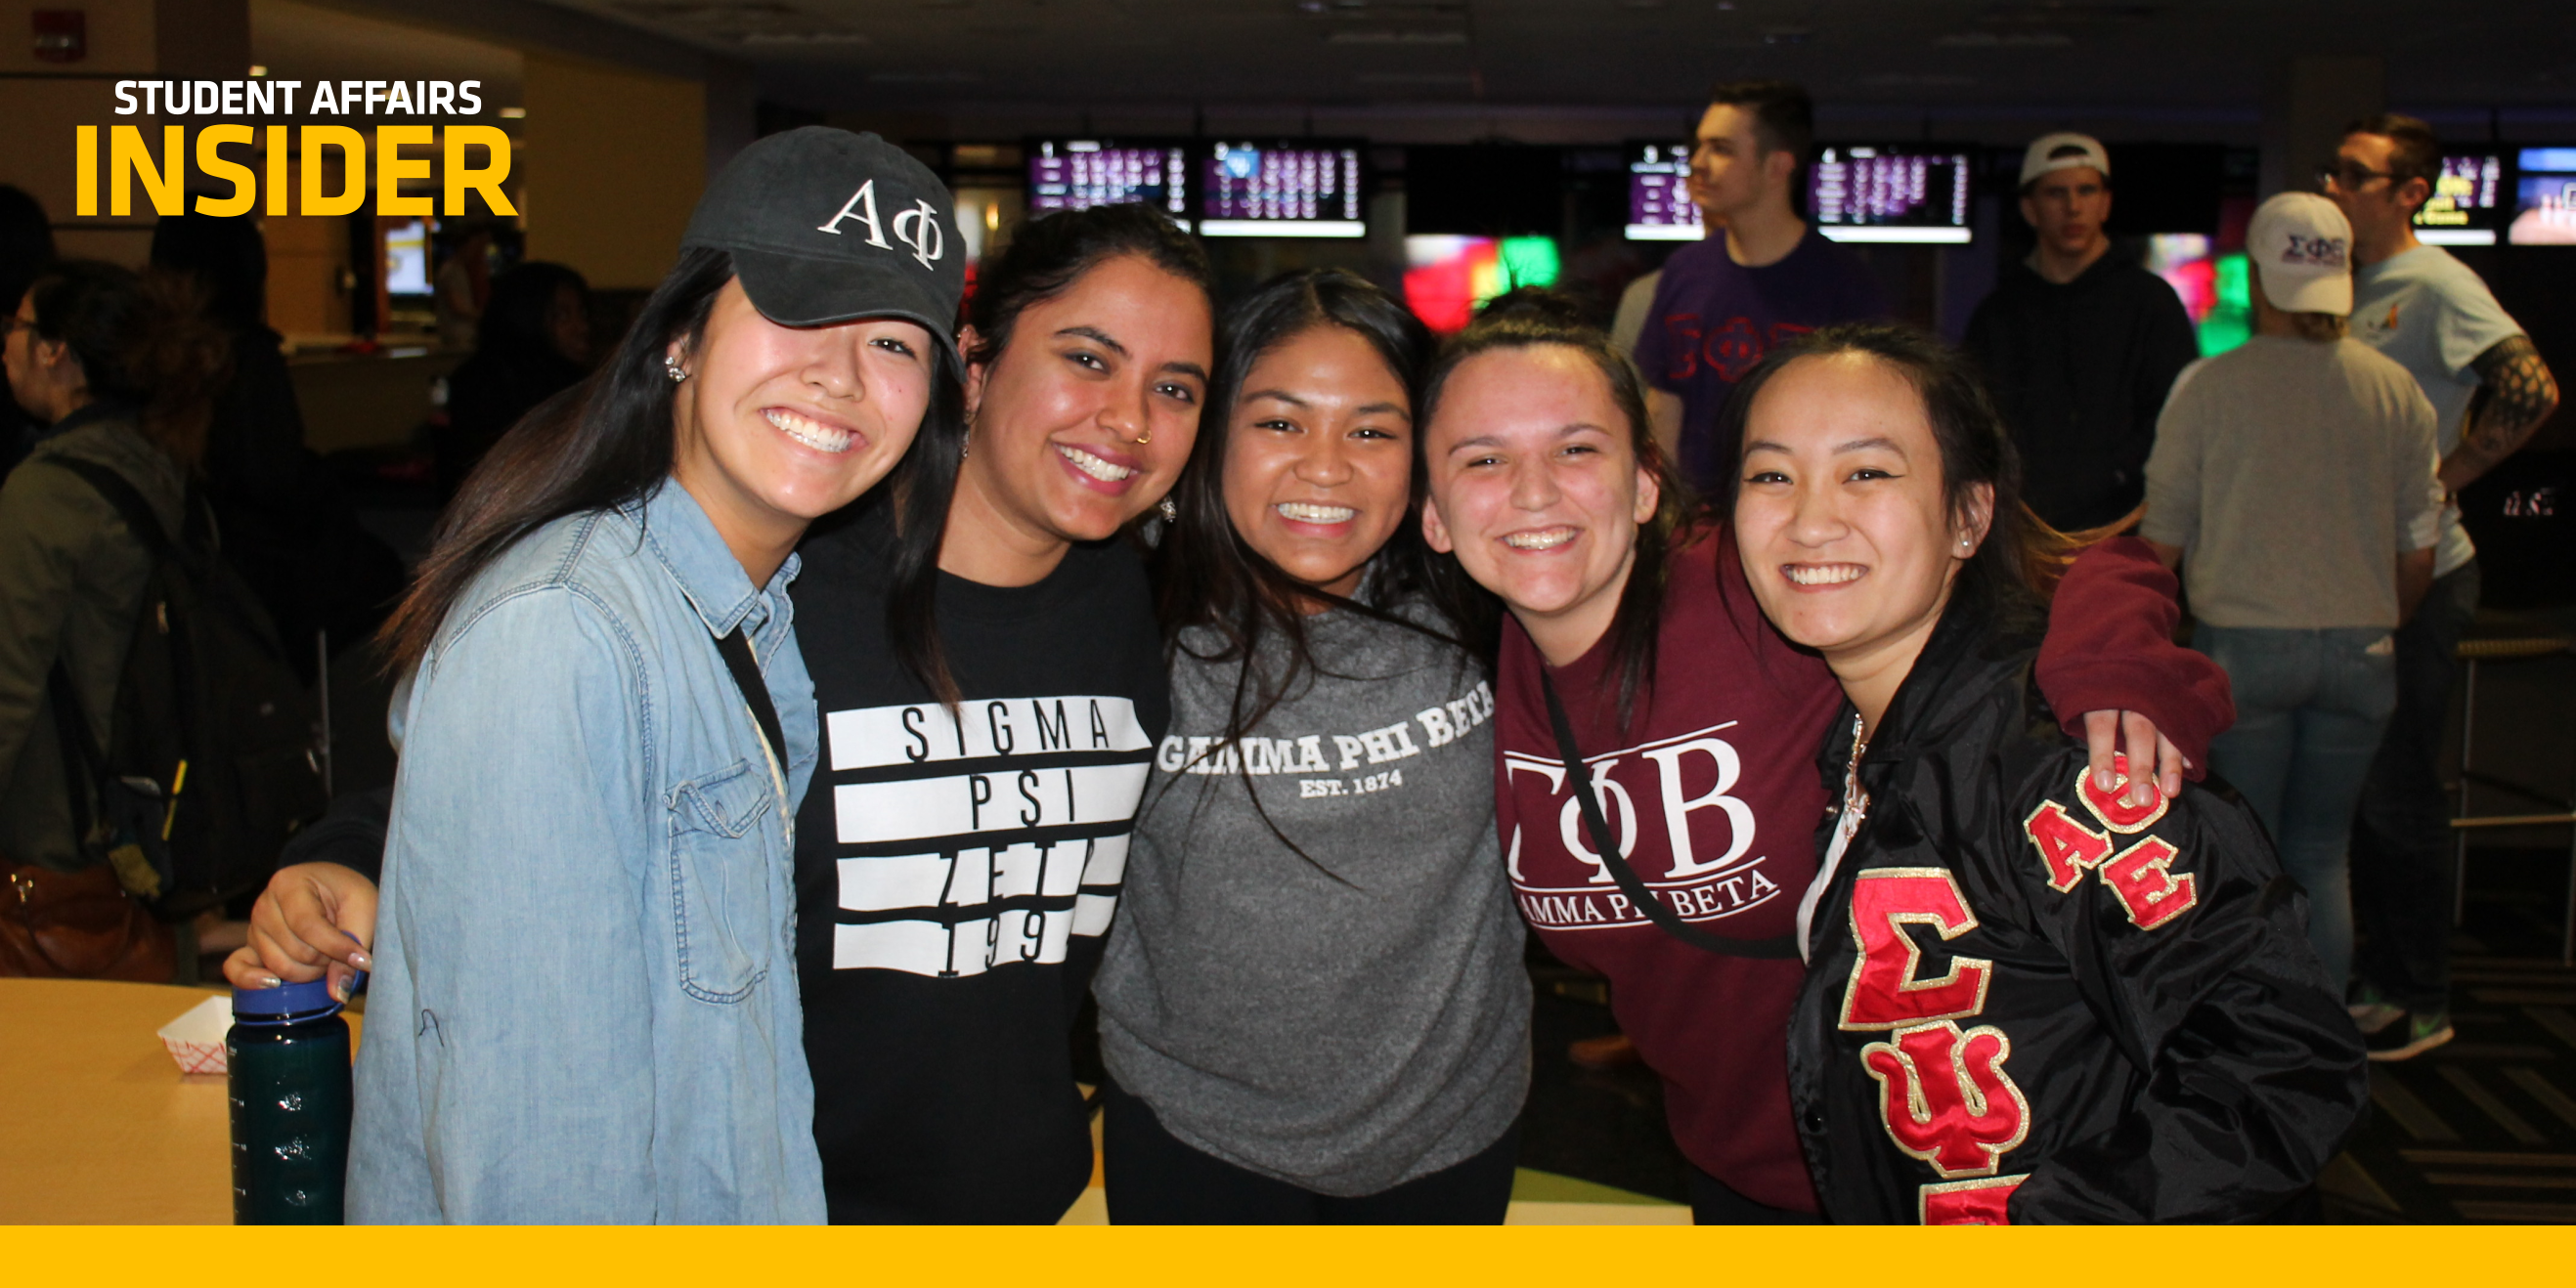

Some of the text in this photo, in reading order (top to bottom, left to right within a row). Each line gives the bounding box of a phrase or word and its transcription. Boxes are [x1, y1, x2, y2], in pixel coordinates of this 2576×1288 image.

[901, 698, 1110, 763] SIGMA
[1157, 679, 1496, 775] GAMMA PHI BETA
[971, 768, 1075, 830] PSI
[1299, 768, 1403, 799] EST. 1874
[1517, 893, 1606, 924] AMMA
[1667, 869, 1779, 917] BETA
